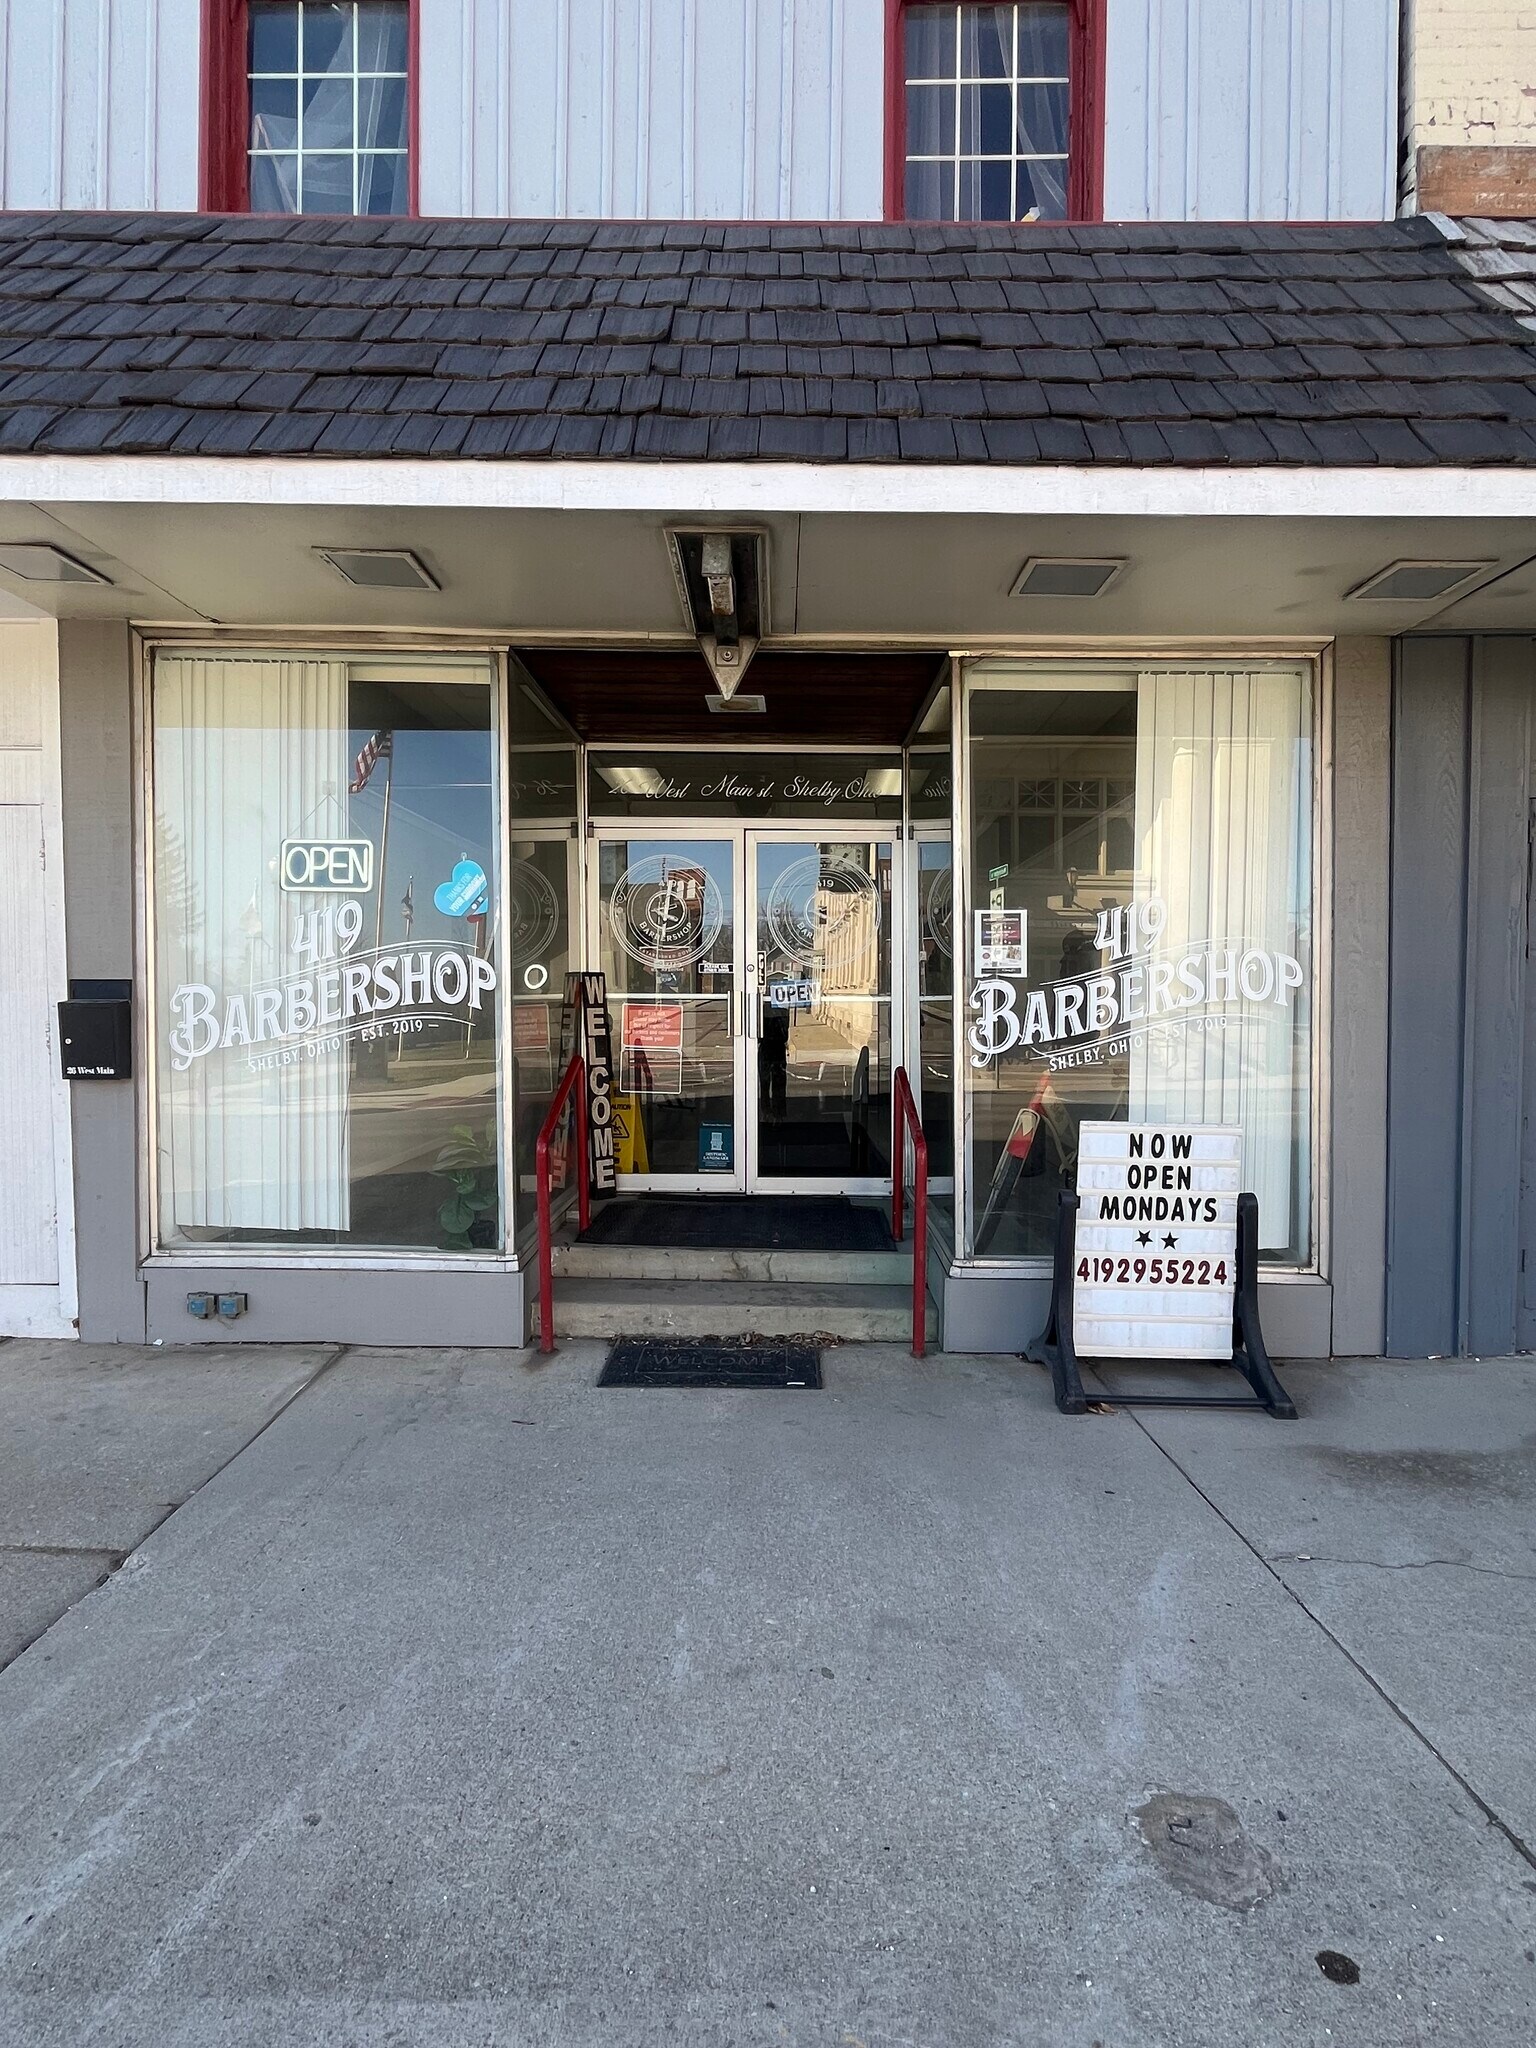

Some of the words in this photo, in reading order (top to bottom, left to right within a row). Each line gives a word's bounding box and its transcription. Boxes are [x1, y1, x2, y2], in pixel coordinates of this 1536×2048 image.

[639, 776, 691, 799] West
[700, 774, 755, 798] Main
[286, 847, 368, 884] OPEN
[291, 900, 363, 965] 419
[1093, 896, 1168, 961] 419
[775, 985, 817, 1002] OPEN
[967, 949, 1304, 1068] BARBERSHOP
[169, 952, 497, 1071] BARBERSHOP
[307, 1038, 340, 1058] OHIO
[361, 1025, 390, 1042] EST.
[393, 1019, 423, 1034] 2019
[1109, 1036, 1143, 1056] OHIO
[1196, 1017, 1228, 1032] 2019
[66, 1066, 77, 1074] 26
[77, 1066, 95, 1074] West
[96, 1066, 115, 1074] Main
[584, 976, 616, 1189] WELCOME
[1129, 1133, 1192, 1159] NOW
[1127, 1164, 1192, 1190] OPEN
[1099, 1195, 1217, 1223] MONDAYS
[1077, 1257, 1228, 1285] 4192955224
[652, 1353, 773, 1367] WELCOME
